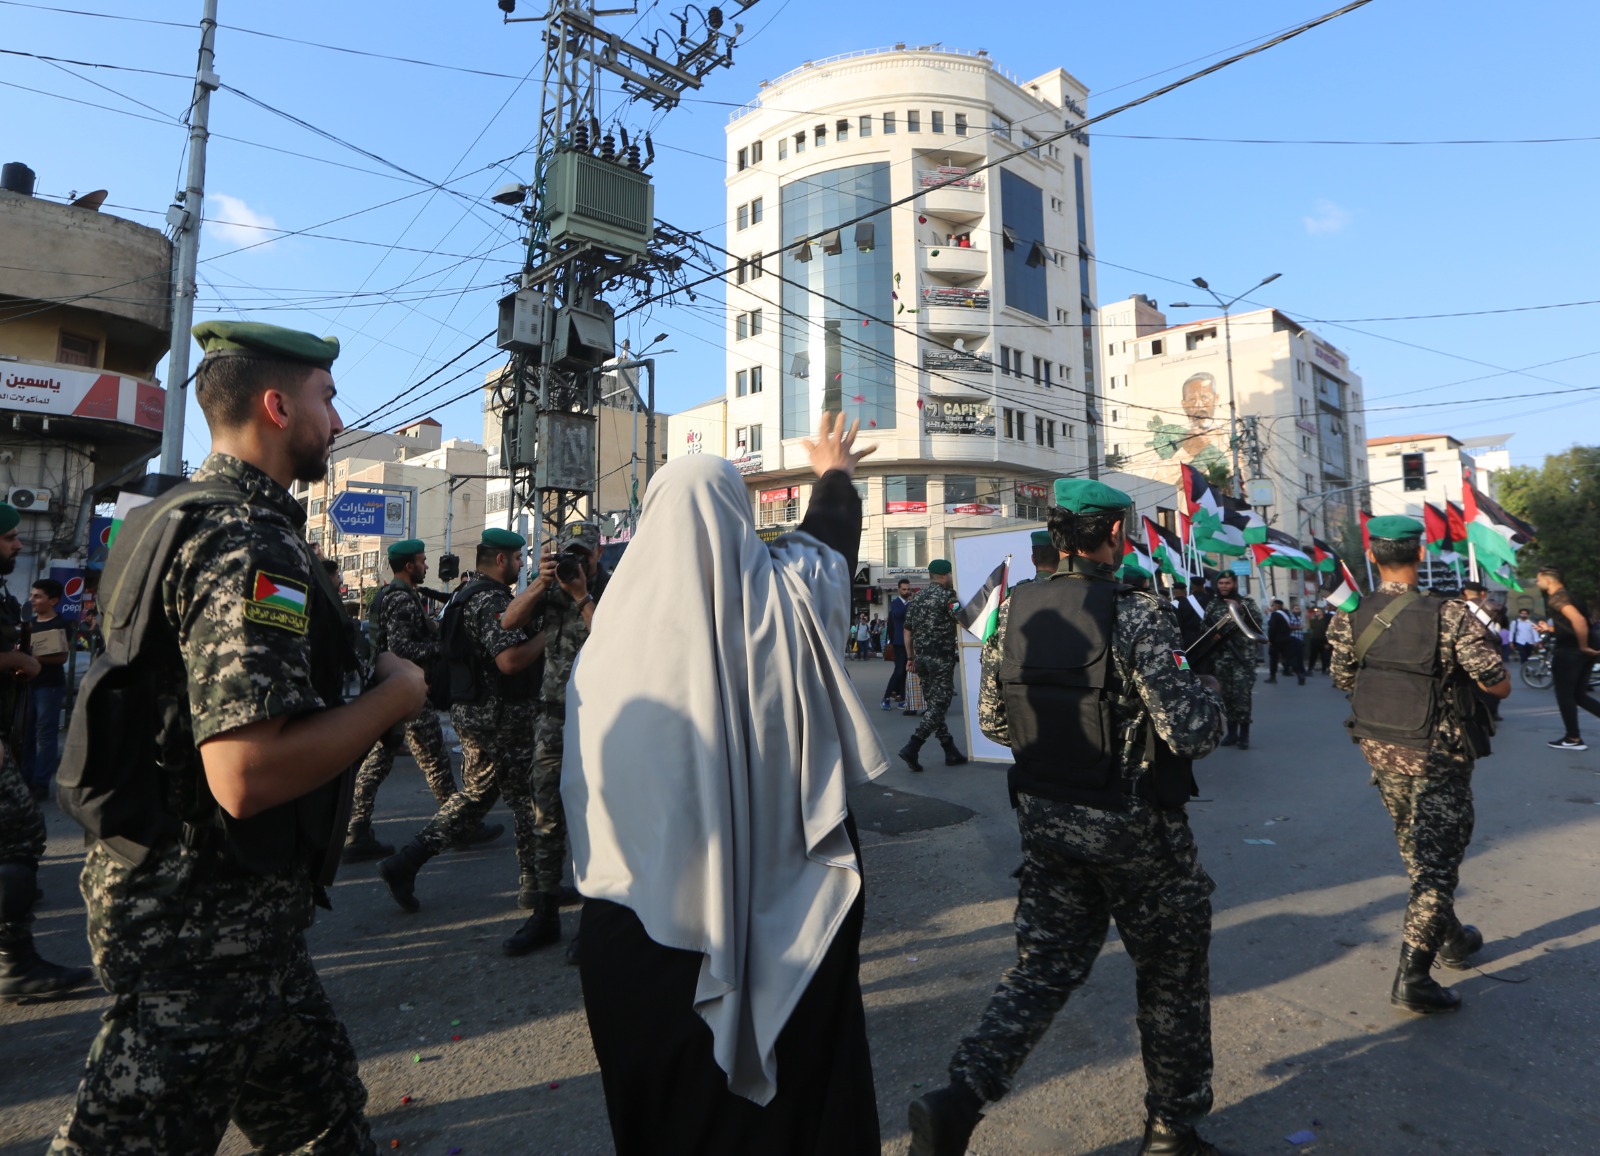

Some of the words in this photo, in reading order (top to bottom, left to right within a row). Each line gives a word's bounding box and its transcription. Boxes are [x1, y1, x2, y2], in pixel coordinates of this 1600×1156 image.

[6, 373, 61, 393] ياسمين
[9, 393, 50, 404] للمأكولات
[339, 502, 375, 515] سيارات
[339, 514, 375, 526] الجنوب
